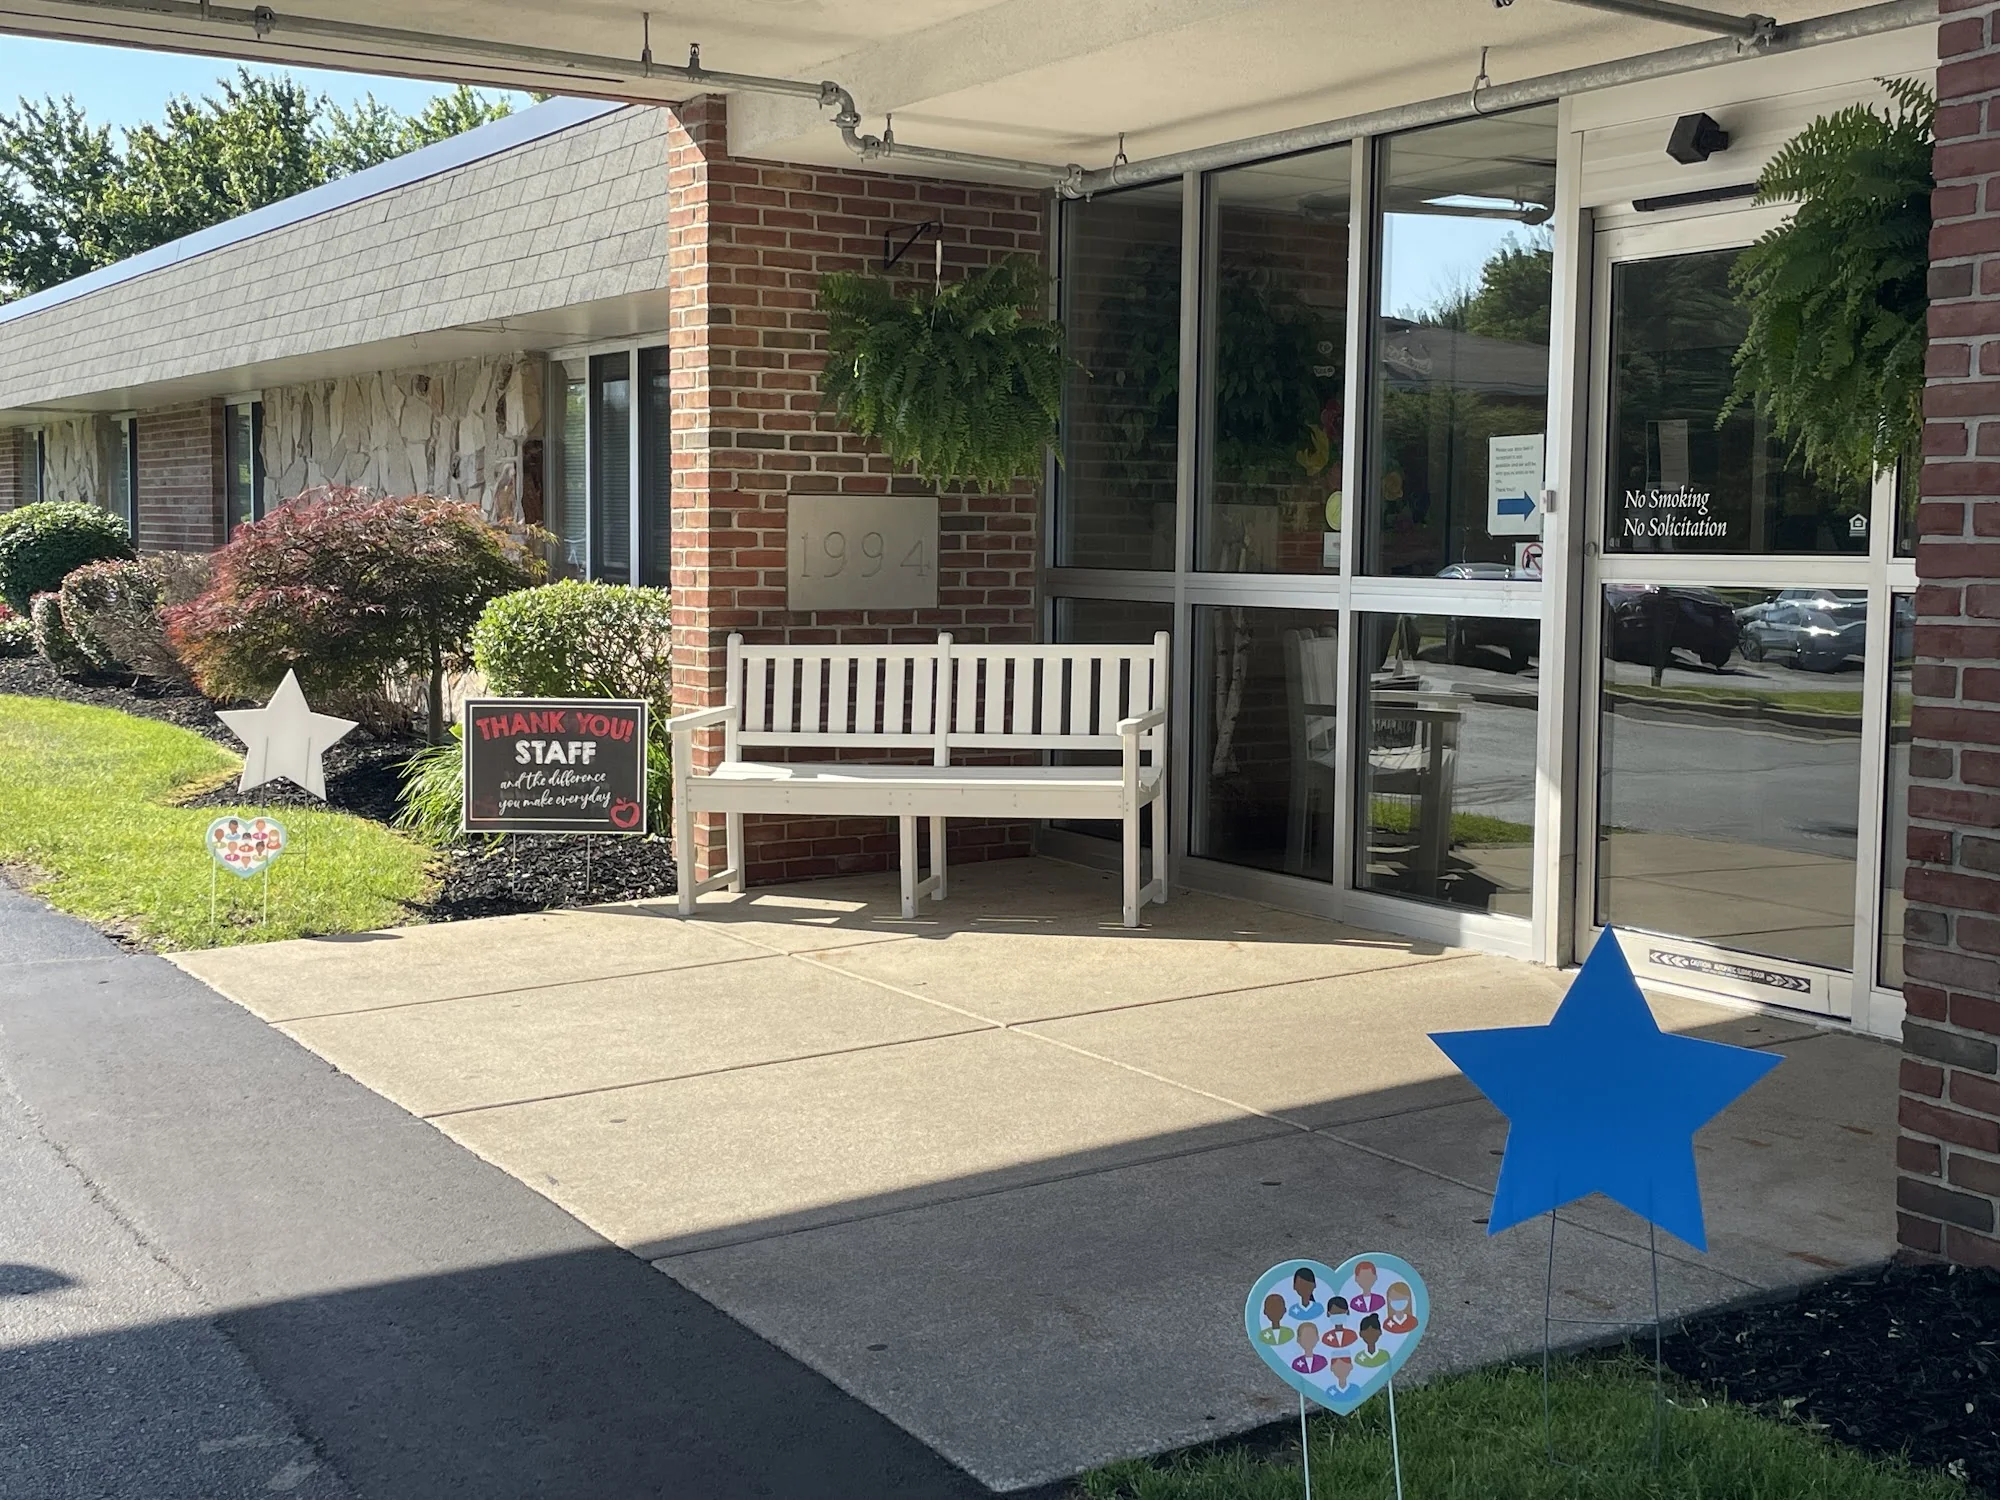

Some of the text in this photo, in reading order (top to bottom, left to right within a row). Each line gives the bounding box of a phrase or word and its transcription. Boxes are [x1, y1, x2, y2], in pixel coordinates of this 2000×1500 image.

[1624, 485, 1710, 515] No Smoking
[1623, 513, 1727, 536] No Solicitation
[801, 531, 930, 578] 1994
[475, 711, 635, 743] THANK YOU!
[515, 739, 597, 765] STAFF
[500, 769, 606, 790] and the difference
[498, 785, 611, 816] you make everyday
